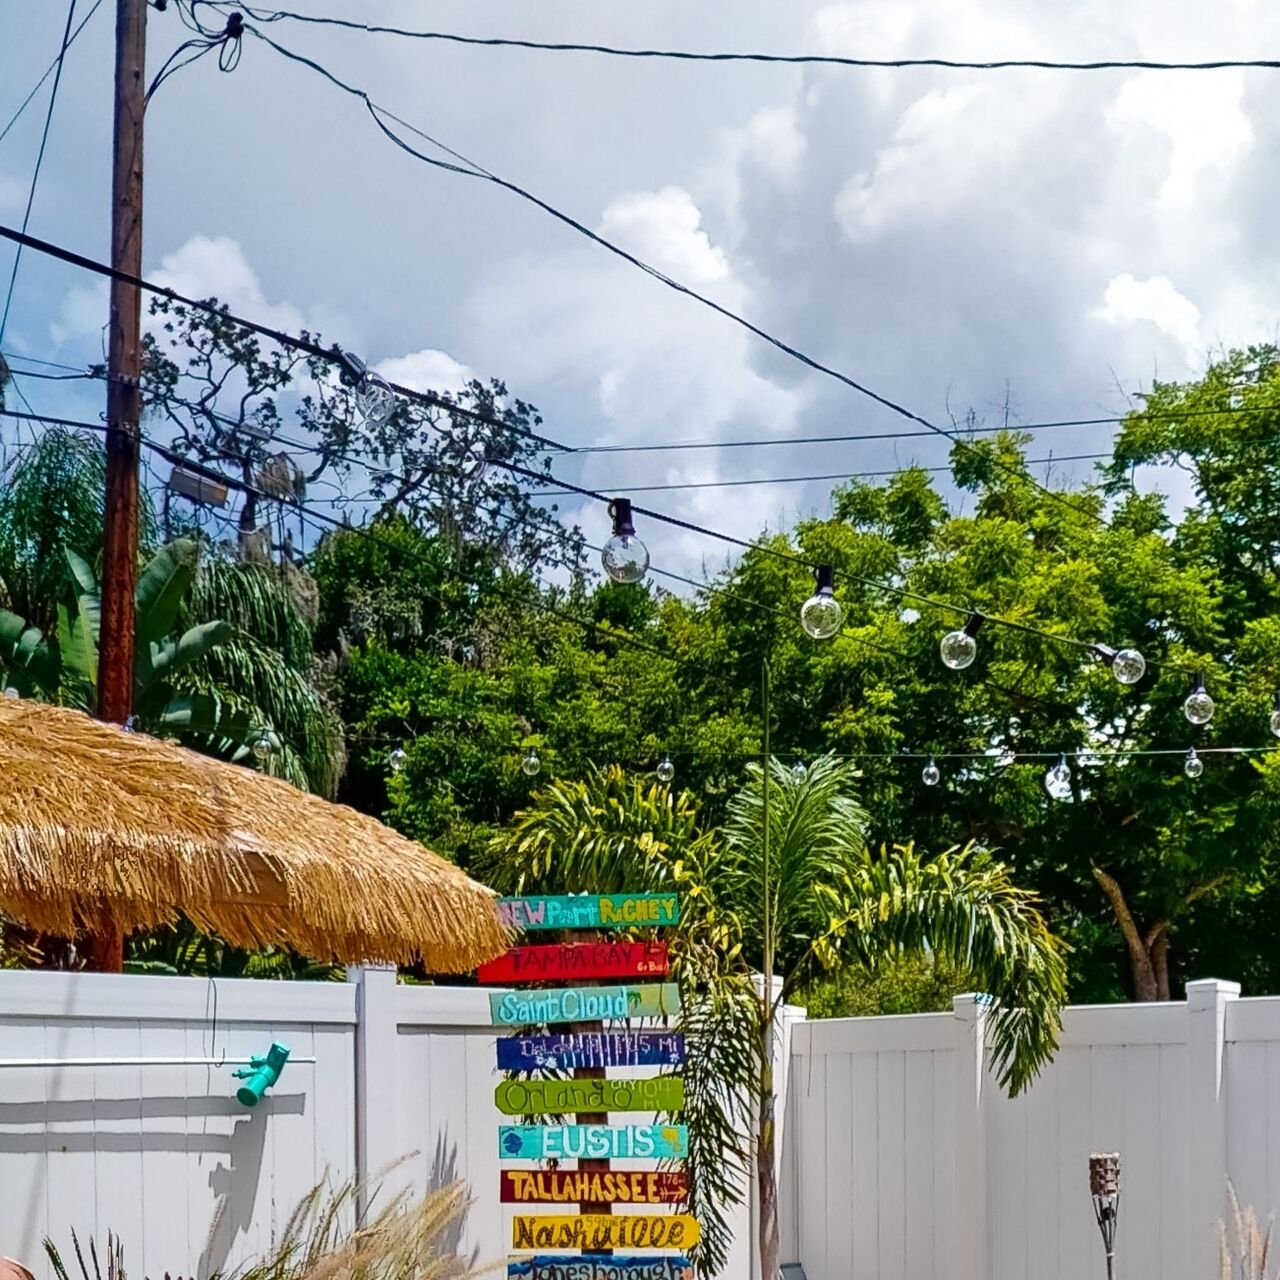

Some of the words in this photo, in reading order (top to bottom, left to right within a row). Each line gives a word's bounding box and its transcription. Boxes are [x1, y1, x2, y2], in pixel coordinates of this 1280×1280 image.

[508, 947, 587, 972] TAMPA
[591, 945, 632, 967] BAY
[498, 991, 559, 1024] Saint
[560, 985, 629, 1020] Cloud
[542, 1126, 656, 1158] EUSTIS
[507, 1171, 661, 1203] TALLAHASSEE
[515, 1217, 687, 1249] Nashville
